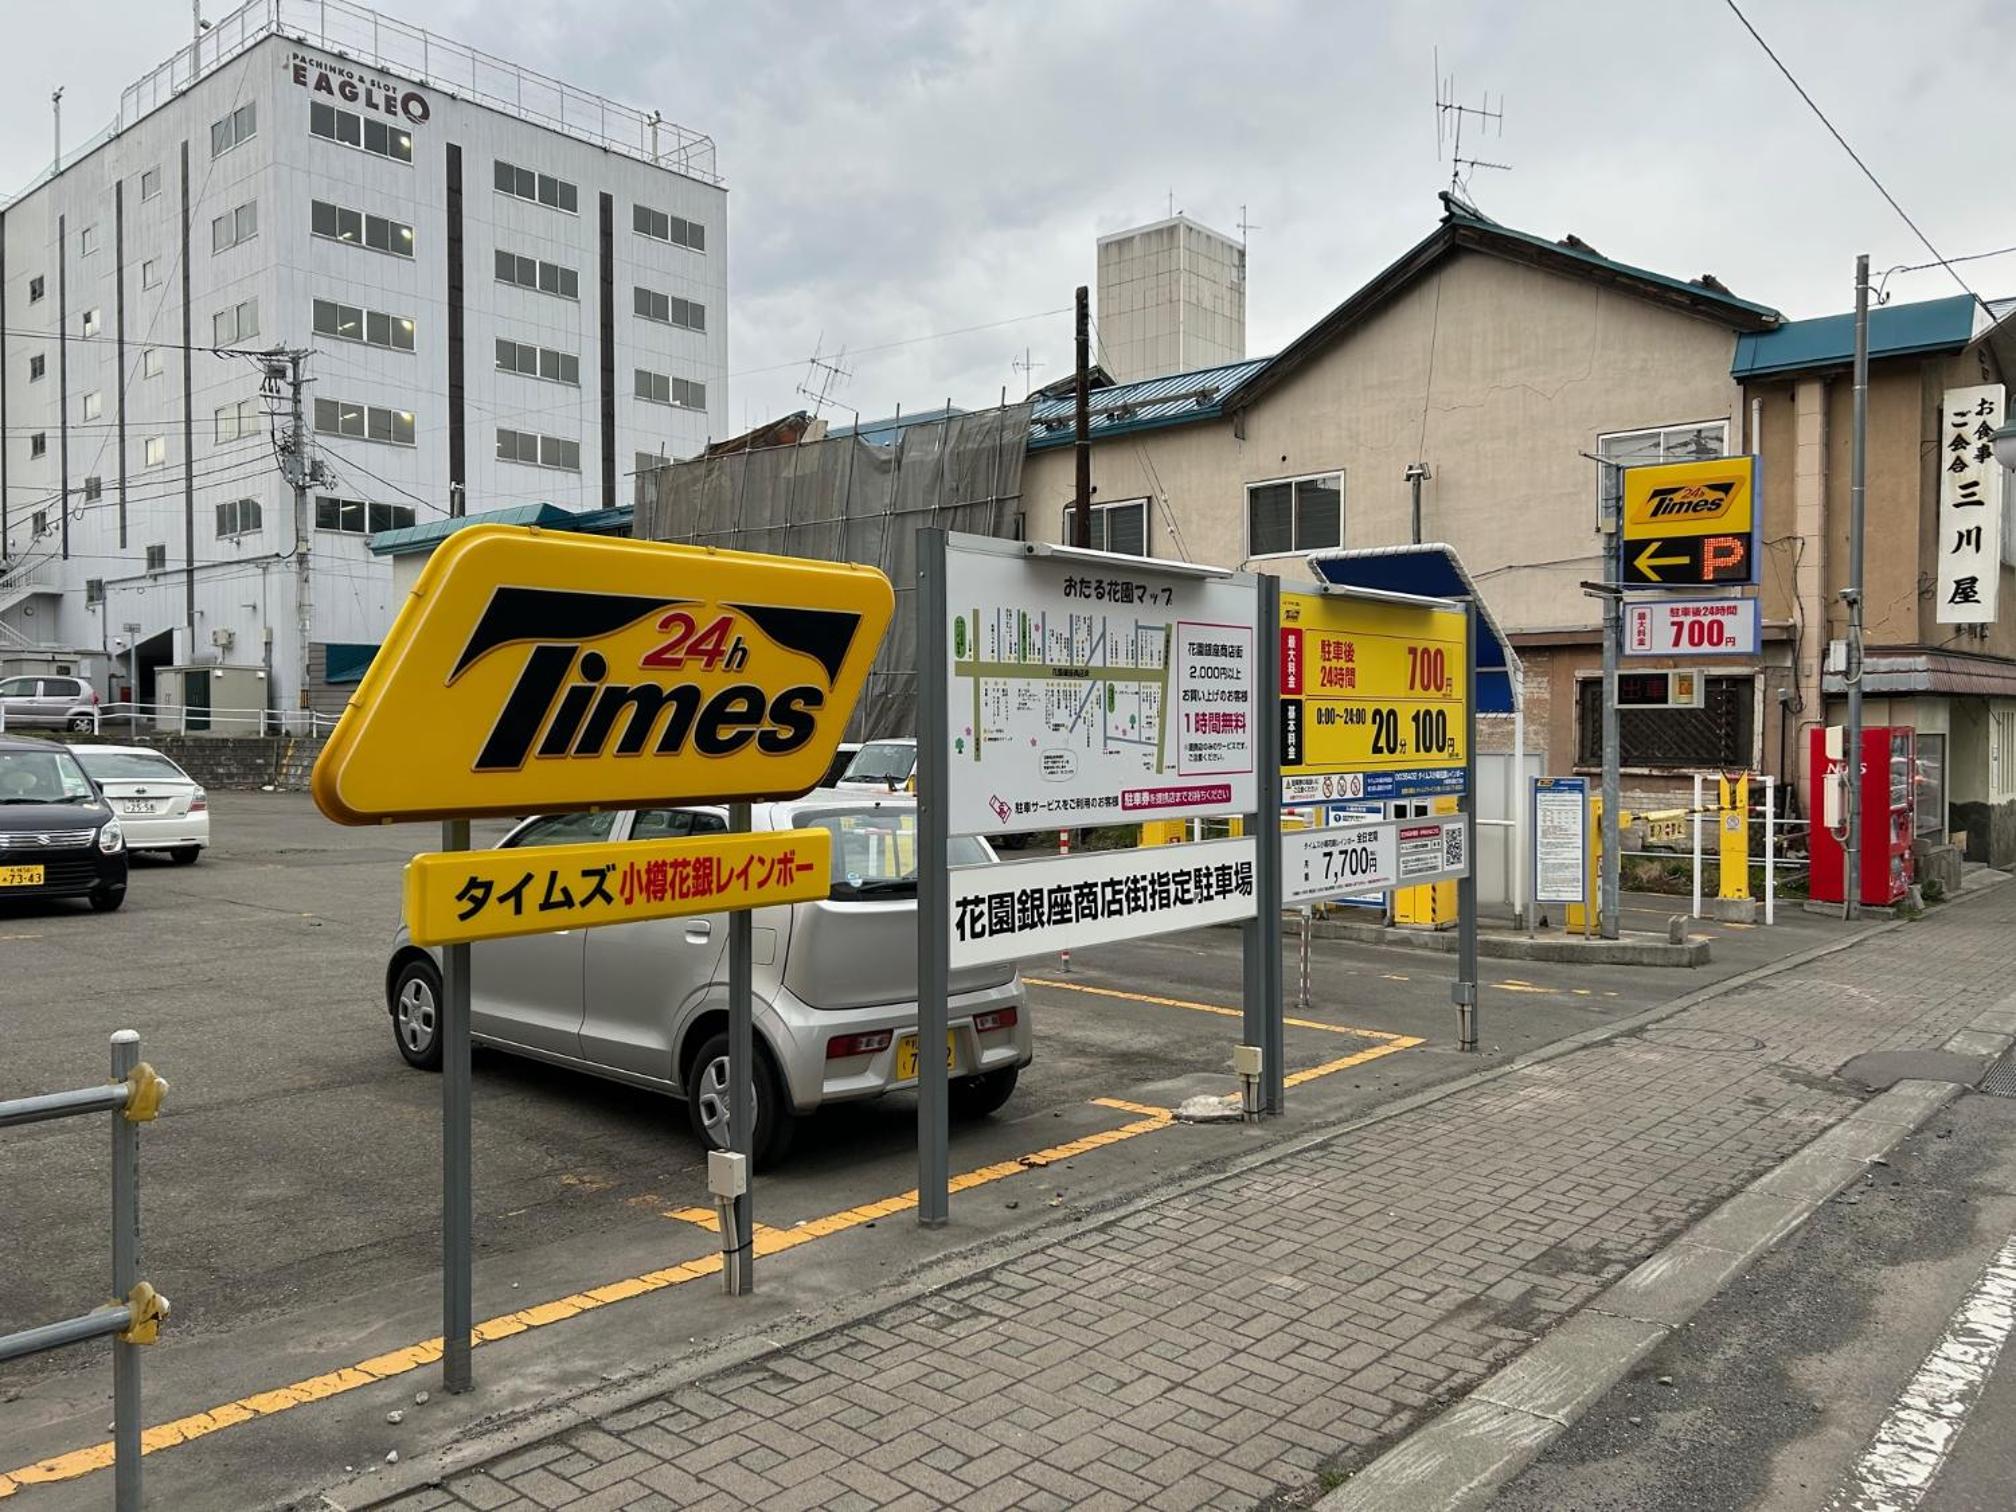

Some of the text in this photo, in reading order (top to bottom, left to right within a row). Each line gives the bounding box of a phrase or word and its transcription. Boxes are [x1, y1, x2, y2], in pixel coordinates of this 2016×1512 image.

[292, 52, 355, 79] PACHINKO
[370, 79, 397, 94] SLOT
[1649, 495, 1725, 518] Times
[1703, 537, 1744, 580] P
[1948, 480, 1985, 604] 三川屋
[1064, 576, 1173, 606] おたる花園マップ
[1670, 605, 1738, 617] 駐車後24時間
[640, 612, 748, 672] 24h
[1670, 619, 1736, 647] 700円
[1320, 639, 1355, 663] 駐車後
[1320, 666, 1355, 689] 24時間
[472, 644, 825, 772] Times
[1184, 711, 1247, 734] 1時間無料
[1323, 846, 1377, 884] 7,700円
[955, 861, 1253, 941] 花園銀座商店街指定駐車場
